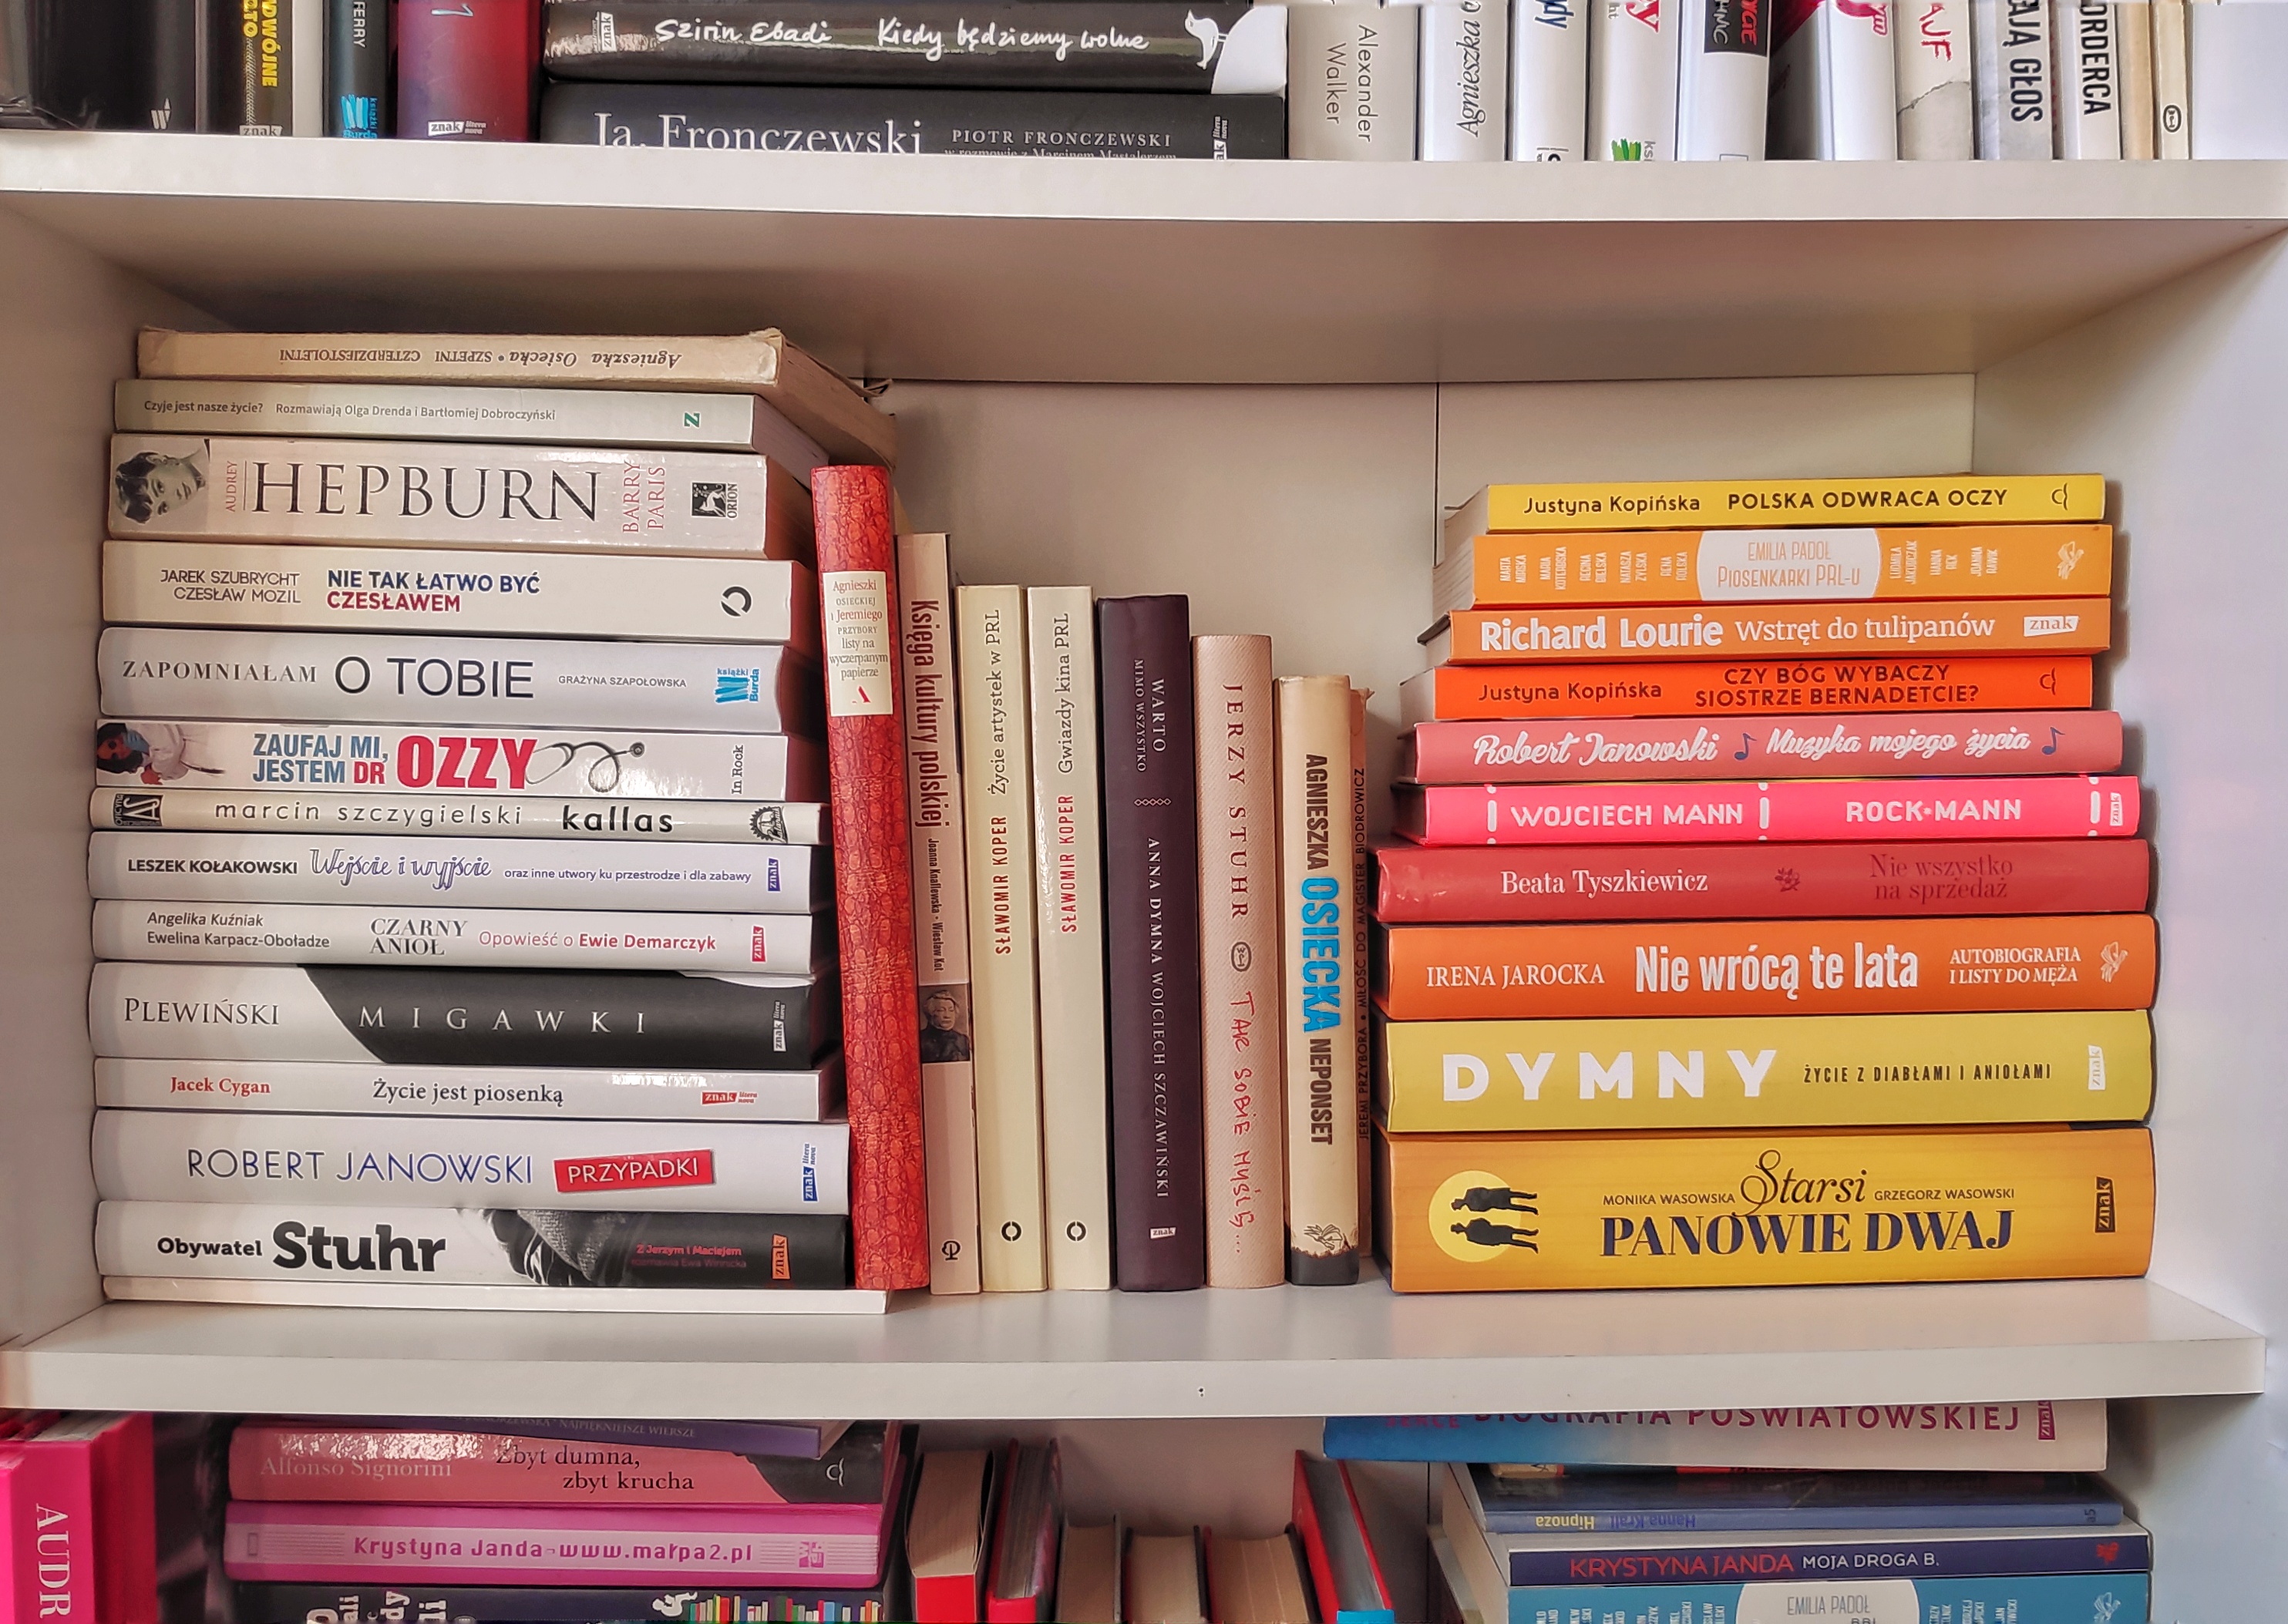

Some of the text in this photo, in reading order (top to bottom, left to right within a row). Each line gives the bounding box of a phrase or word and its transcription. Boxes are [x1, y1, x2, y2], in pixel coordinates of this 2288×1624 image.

[877, 17, 944, 62] Kiedy
[957, 18, 1074, 61] będziemy
[1079, 19, 1149, 51] wolne
[1326, 42, 1348, 124] Walker
[1357, 24, 1380, 143] Alexander
[1455, 18, 1486, 139] Agnieszka
[2009, 59, 2043, 123] GŁOS
[951, 130, 1172, 148] PIOTR FRONCZEWSKI
[280, 349, 682, 368] Agnieszka Osiecka SZPETNI CZTERDZIESTOLETNI
[144, 401, 263, 415] Czyje jest nasze życie?
[275, 403, 556, 422] Rozmawiają Olga Drenda Bartłomiej Dobroczyński
[225, 461, 238, 512] AUDREY
[251, 461, 601, 523] HEPBURN
[1728, 489, 2007, 509] POLSKA ODWRACA OCZY
[726, 483, 738, 519] ORION
[1524, 494, 1700, 516] Justyna Kopińska
[1748, 541, 1832, 560] EMILIA PADOŁ
[833, 580, 877, 593] Agnieszki
[836, 597, 876, 606] OSIECKIEJ
[836, 608, 883, 621] Jeremiego
[838, 626, 877, 635] PRZYBORY
[1481, 613, 1723, 651] Richard Lourie
[1735, 612, 1995, 645] Wstręt do tulipanów
[842, 638, 860, 651] listy
[829, 654, 888, 666] wyczerpanym
[123, 656, 533, 698] ZAPOMNIAŁAM O TOBIE
[558, 674, 687, 688] GRAŻYNA SZAPOŁOWSKA
[749, 668, 759, 702] Burda
[841, 667, 879, 681] papierze
[985, 610, 1009, 795] Życie artystek w PRL
[1054, 614, 1075, 773] Gwiazdy kina PRL
[907, 600, 950, 828] Księga kultury polskiej
[1134, 659, 1146, 772] MIMO WSZYSTKO
[1472, 727, 1721, 767] Robert Janowski
[1766, 724, 2031, 761] Muzyka mojego życia
[215, 802, 522, 827] marcin szczygielski
[562, 805, 673, 834] kallas
[1306, 754, 1328, 870] AGNIESZKA
[1354, 768, 1365, 854] BIODROWICZ
[504, 868, 752, 883] oraz inne utwory ku przestrodze dla zabawy
[991, 816, 1011, 955] SŁAWOMIR KOPER
[1354, 863, 1367, 924] MAGISTER
[146, 913, 264, 926] Angelika Kuźniak
[147, 931, 330, 949] Ewelina Karpacz-Oboładze
[479, 930, 716, 953] Opowieść o Ewie Demarczyk
[1356, 931, 1366, 952] DO
[1300, 876, 1341, 1033] OSIECKA
[1949, 946, 2081, 965] AUTOBIOGRAFIA
[1635, 942, 1919, 1000] Nie wrócą te lata
[1959, 965, 2078, 986] LISTY DO MĘŻA
[124, 998, 279, 1026] PLEWIŃSKI
[358, 1006, 644, 1033] MIGAWKI
[1148, 838, 1169, 1197] ANNA DYMNA WOJCIECH SZCZAWIŃSKI
[1356, 1027, 1368, 1094] PRZYBORA
[1804, 1063, 2051, 1083] ŻYCIE Z DIABŁAMI ANIOŁAMI
[372, 1078, 564, 1108] Życie jest piosenką
[1358, 1100, 1369, 1140] JEREMI
[1603, 1193, 1735, 1205] MONIKA WASOWSKA
[1874, 1189, 2014, 1201] GRZEGORZ WASOWSKI
[2098, 1179, 2111, 1229] znak
[157, 1220, 446, 1273] Obywatel Stuhr
[1600, 1210, 2014, 1256] PANOWIE DWAJ
[775, 1239, 786, 1276] znak
[261, 1458, 453, 1481] Alfonso Signorini
[496, 1445, 639, 1470] Zbyt dumna,
[563, 1471, 694, 1494] zbyt krucha
[1535, 1515, 1595, 1530] Hipnoza
[1649, 1515, 1696, 1529] Hanna
[355, 1537, 462, 1559] Krystyna
[471, 1540, 542, 1557] Janda
[1802, 1553, 1940, 1570] MOJA DROGA B.
[1570, 1552, 1794, 1578] KRYSTYNA JANDA
